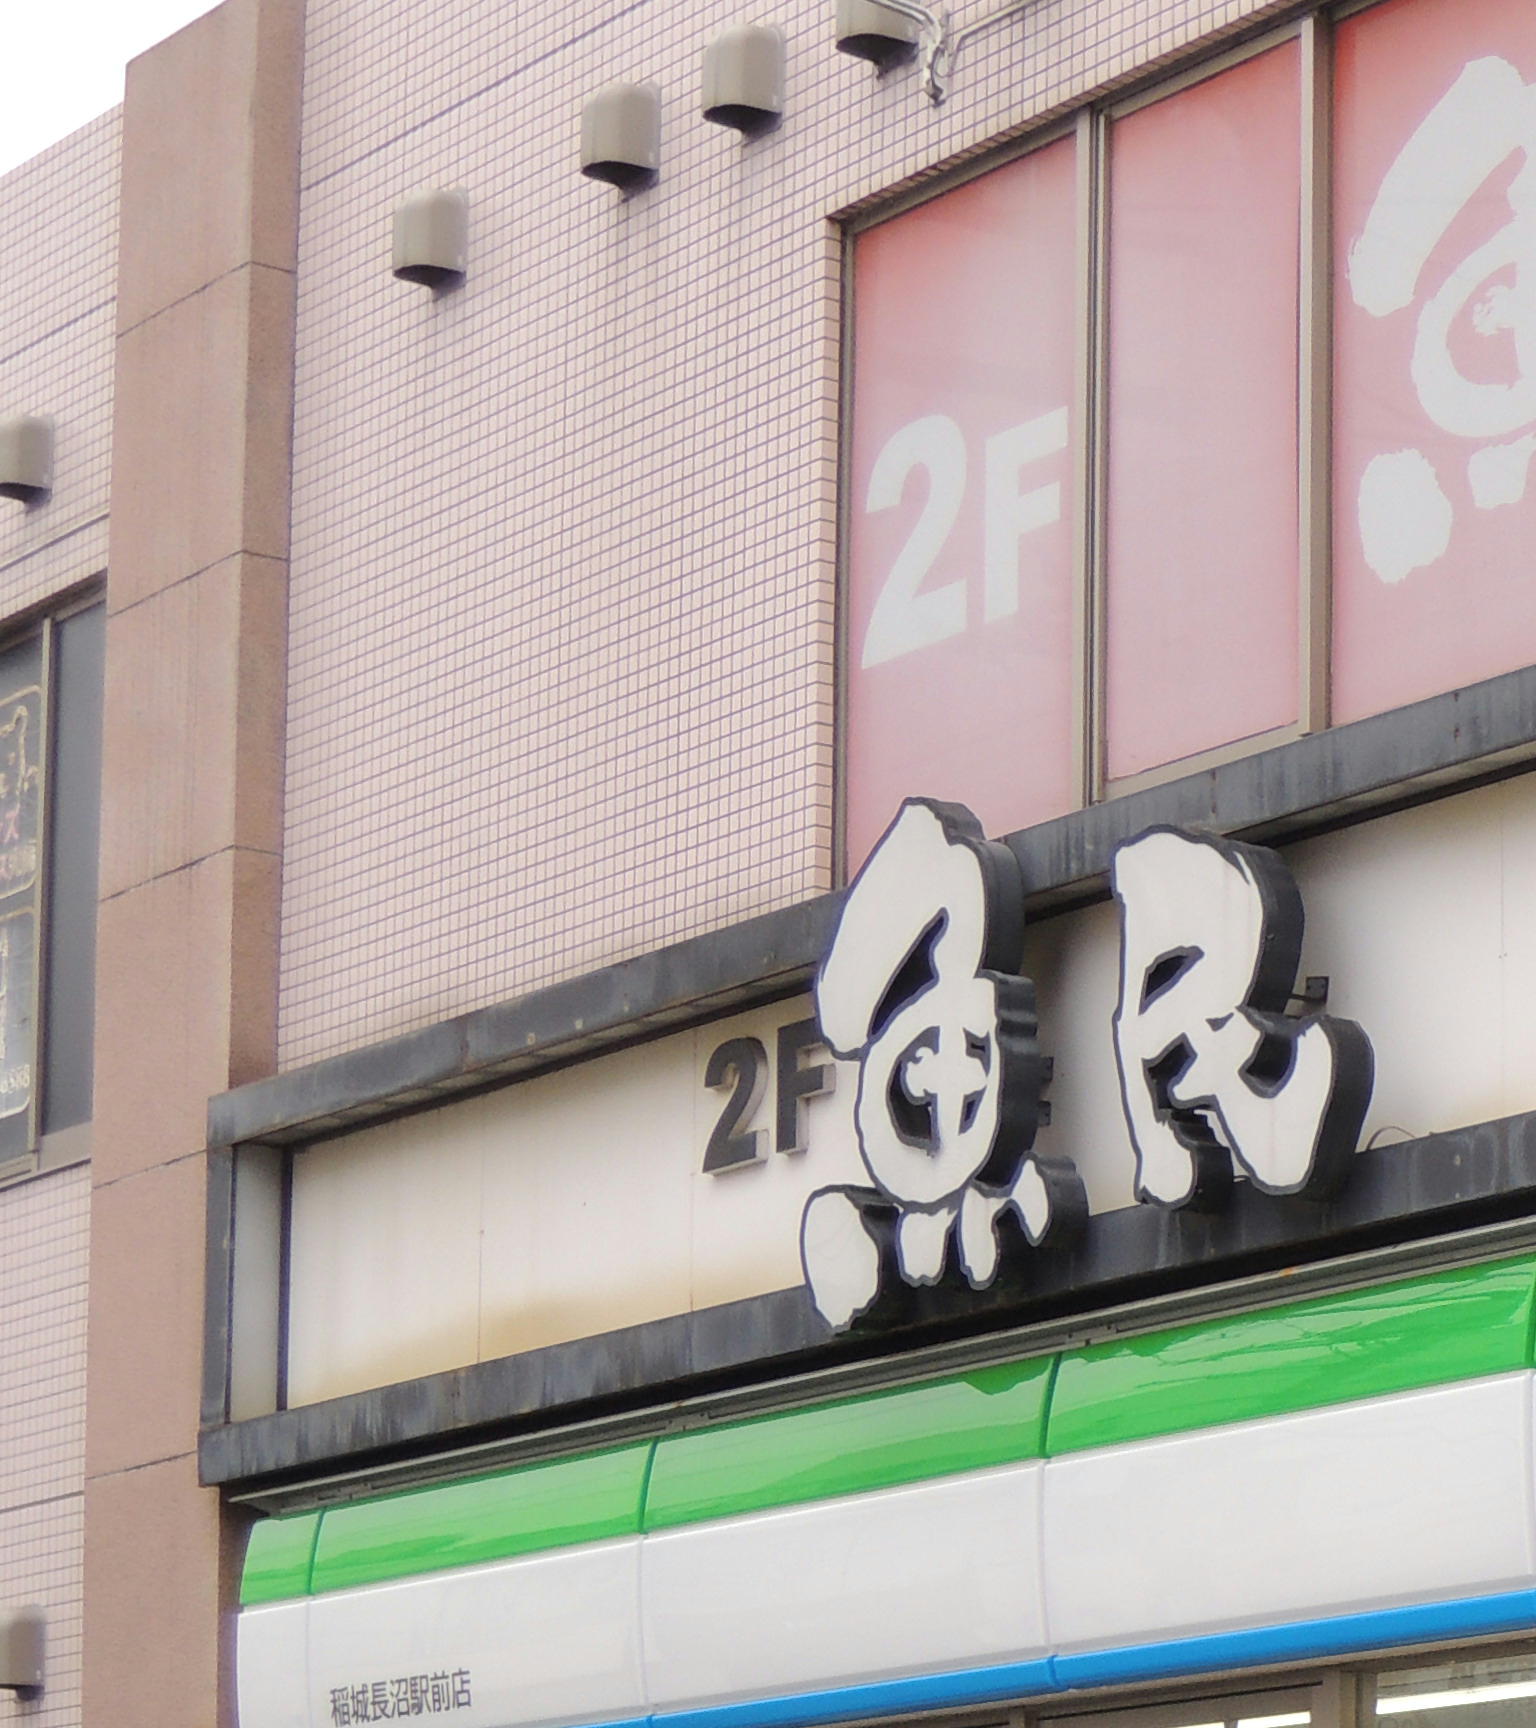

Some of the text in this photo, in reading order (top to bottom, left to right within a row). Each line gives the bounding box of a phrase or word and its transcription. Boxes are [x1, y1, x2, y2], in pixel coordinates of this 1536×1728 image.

[862, 405, 1068, 670] 2F
[703, 797, 1372, 1336] 2F 魚民
[330, 1668, 471, 1728] 稲城長沼駅前店
